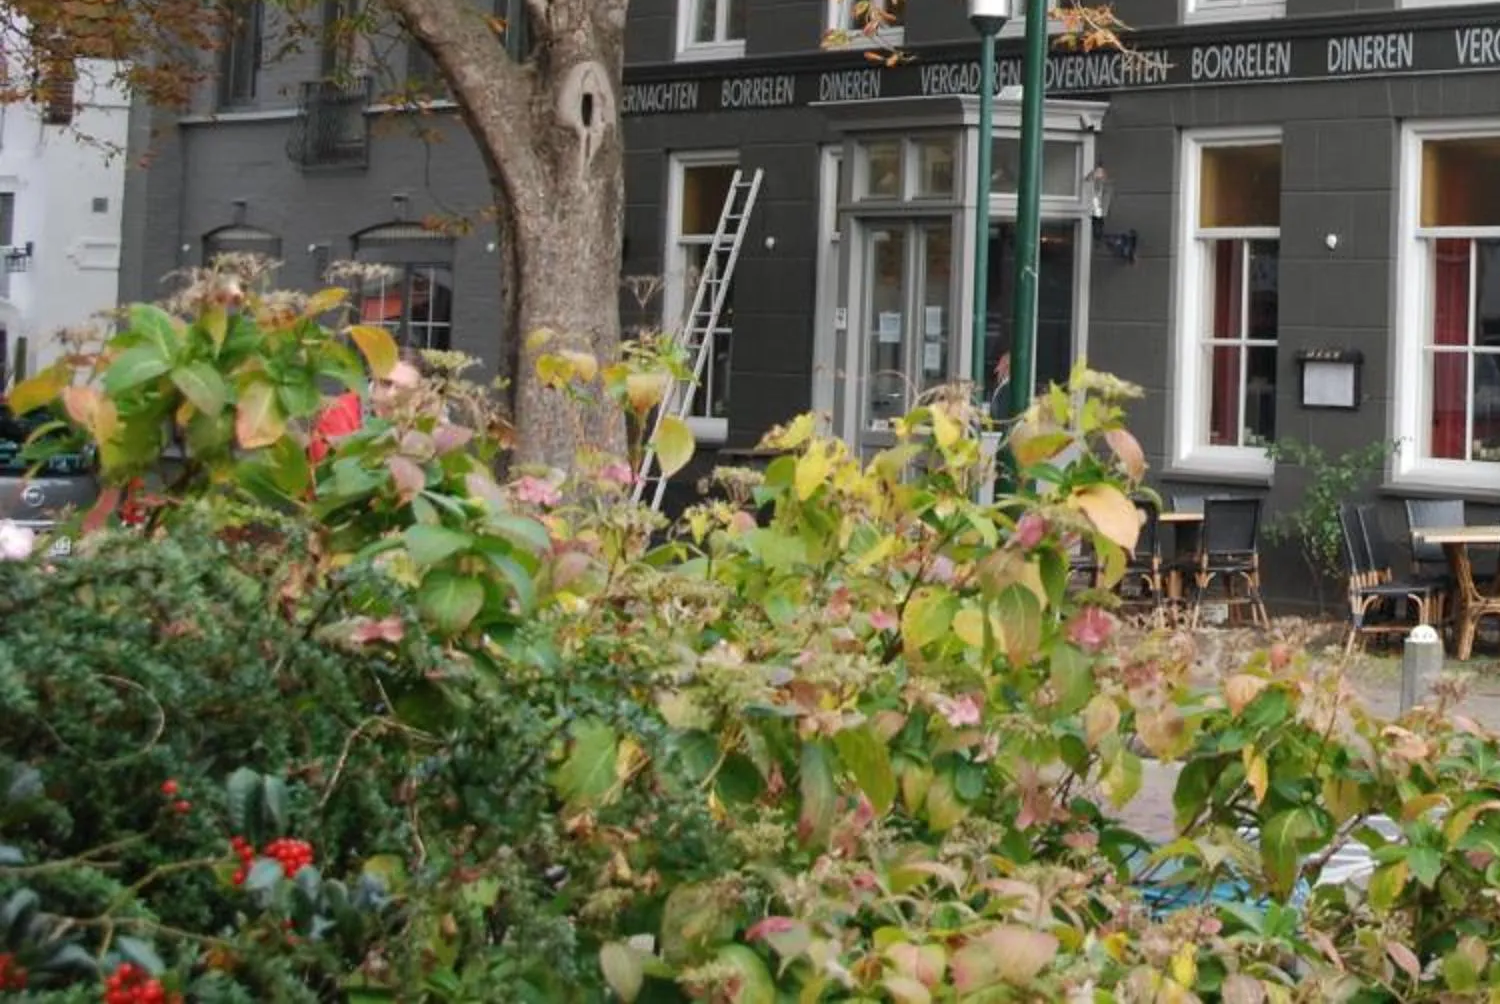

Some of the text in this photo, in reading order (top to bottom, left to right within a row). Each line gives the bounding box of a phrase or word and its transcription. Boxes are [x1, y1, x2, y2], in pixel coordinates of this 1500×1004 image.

[623, 82, 699, 112] ERNACHTEN
[721, 75, 796, 107] BORRELEN
[819, 68, 881, 101] DINEREN
[920, 59, 1022, 95] VERGADREN
[1191, 41, 1292, 79] BORRELEN
[1327, 32, 1414, 73] DINEREN
